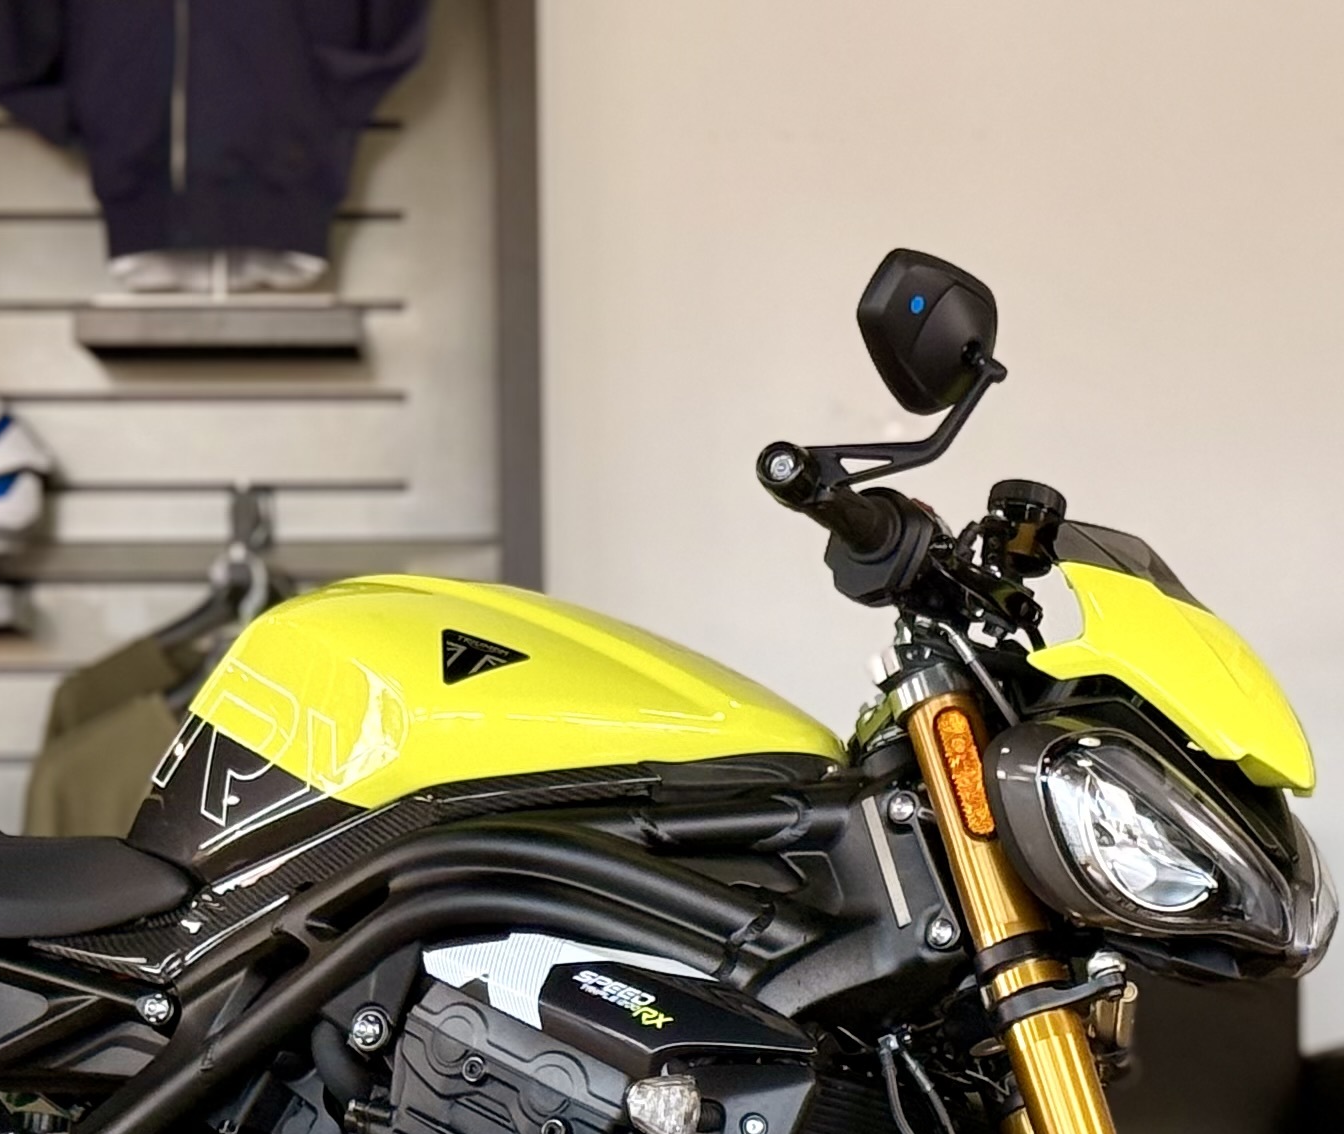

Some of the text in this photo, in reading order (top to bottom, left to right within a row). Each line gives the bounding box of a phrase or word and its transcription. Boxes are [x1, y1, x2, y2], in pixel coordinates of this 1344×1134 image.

[457, 634, 510, 657] TRIUMPH
[572, 970, 657, 1006] SPEED
[631, 1006, 675, 1030] RX
